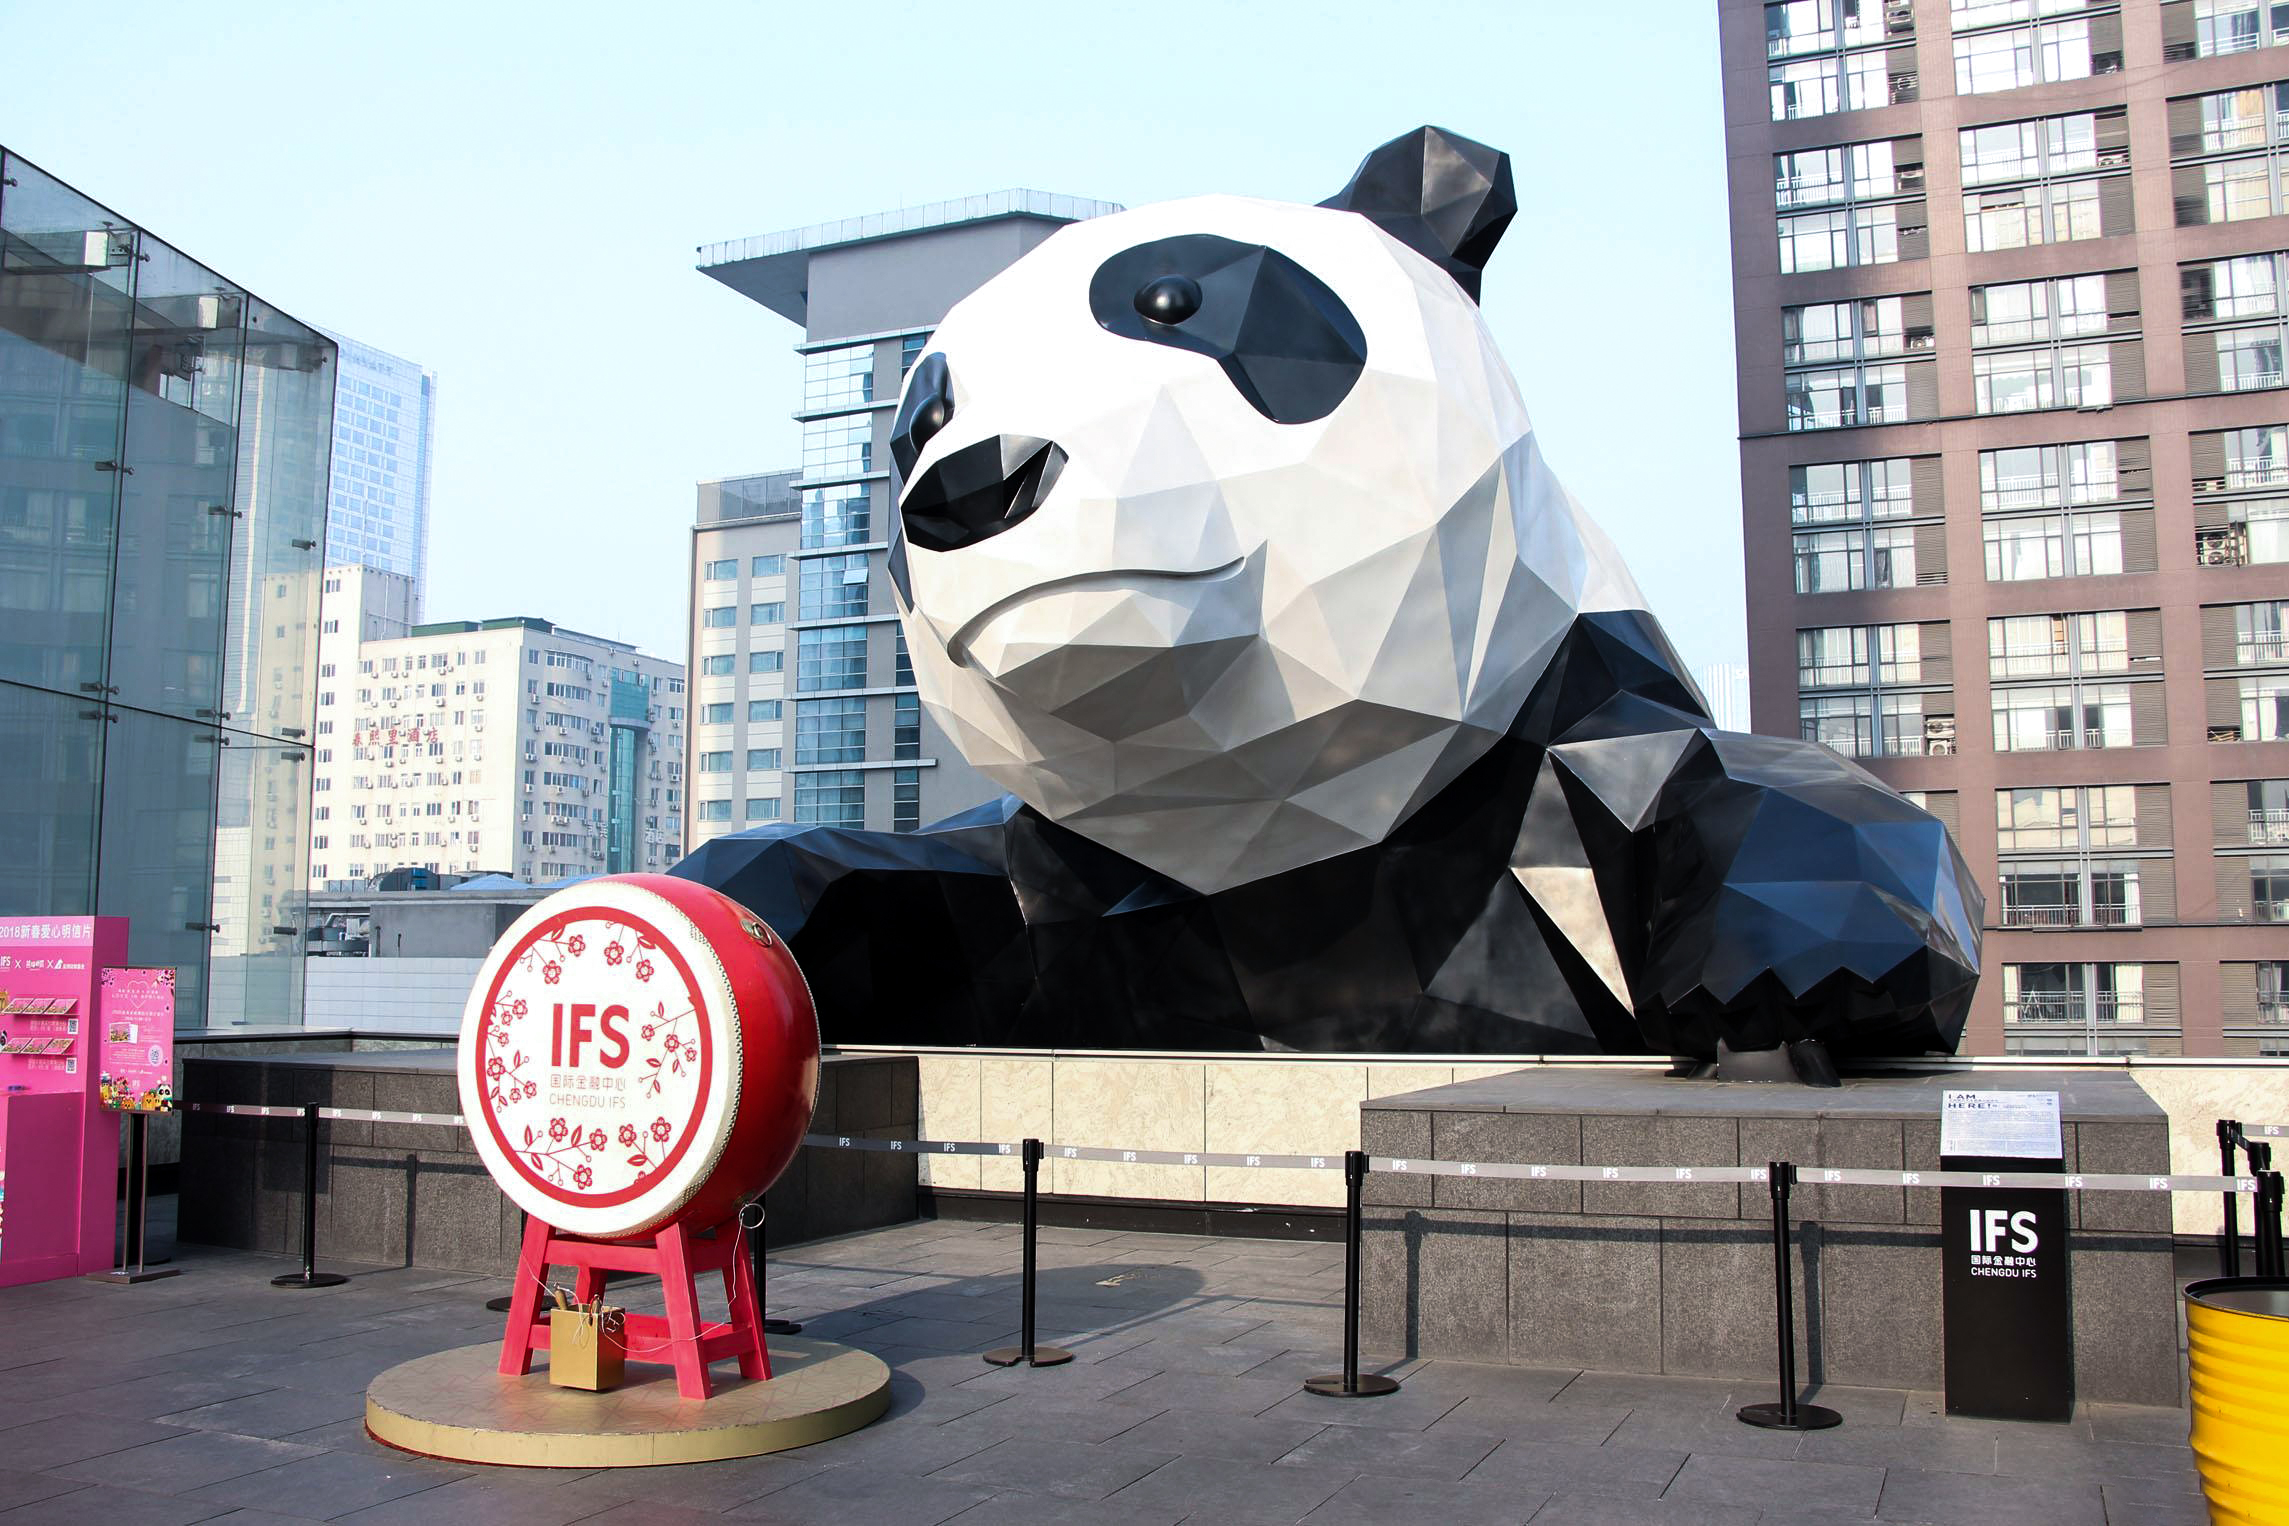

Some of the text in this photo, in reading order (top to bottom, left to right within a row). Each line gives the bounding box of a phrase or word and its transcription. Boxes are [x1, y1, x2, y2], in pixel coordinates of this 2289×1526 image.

[551, 1003, 630, 1069] IFS
[551, 1074, 625, 1091] 国际金融中心
[549, 1093, 625, 1109] CHENGDU IFS
[2264, 1125, 2279, 1135] IFS
[839, 1137, 1011, 1153] IFS IFS IFS IFS
[1064, 1147, 1325, 1168] IFS IFS IFS IFS IFS
[1392, 1160, 1767, 1179] IFS IFS IFS IFS IFS IFS
[1824, 1170, 2257, 1191] IFS IFS IFS IFS IFS IFS
[1970, 1209, 2039, 1254] IFS
[1971, 1255, 2036, 1267] 国际金融中心
[1971, 1267, 2036, 1278] CHENGDU IFS
